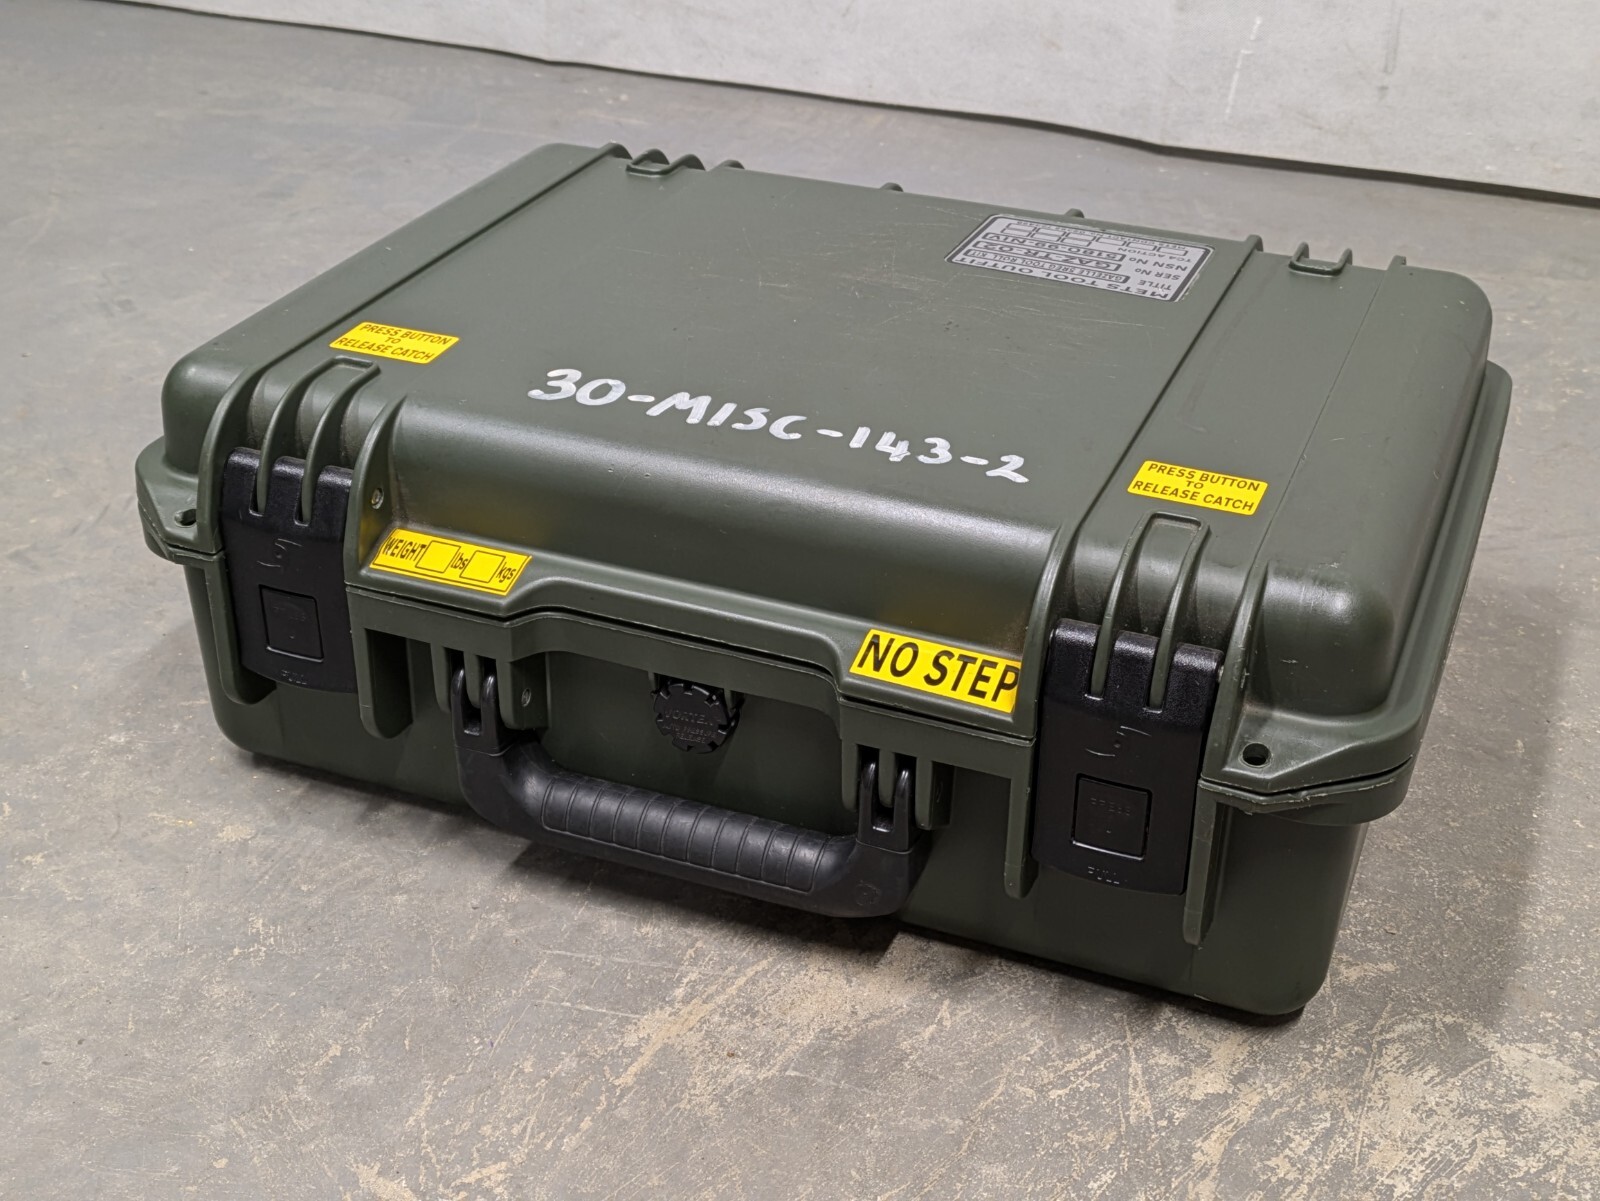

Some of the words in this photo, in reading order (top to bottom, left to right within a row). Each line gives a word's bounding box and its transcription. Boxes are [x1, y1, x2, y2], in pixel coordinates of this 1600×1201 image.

[984, 243, 1110, 269] GAZ-TR-02
[993, 254, 1018, 263] ROLL
[1118, 247, 1166, 257] ACTION
[954, 257, 1033, 274] OUTFIT
[1021, 259, 1047, 268] TOOL
[1129, 257, 1149, 265] No
[1152, 261, 1187, 271] NSN
[1042, 270, 1099, 286] TOOL
[1078, 265, 1123, 281] GAZELLE
[1135, 268, 1152, 276] No
[1154, 271, 1181, 280] SER
[1107, 283, 1169, 299] METS
[1137, 279, 1172, 291] TITLE
[360, 324, 401, 337] PRESS
[400, 331, 452, 345] BUTTON
[384, 336, 401, 344] TO
[335, 337, 392, 353] RELEASE
[390, 347, 434, 360] CATCH
[1148, 463, 1196, 479] PRESS
[1199, 472, 1260, 491] BUTTON
[1186, 480, 1204, 489] TO
[1132, 480, 1200, 501] RELEASE
[1203, 494, 1254, 511] CATCH
[382, 536, 427, 562] WEIGHT
[450, 552, 469, 570] lbs
[496, 562, 516, 583] kgs
[856, 633, 919, 678] NO
[923, 649, 1020, 702] STEP
